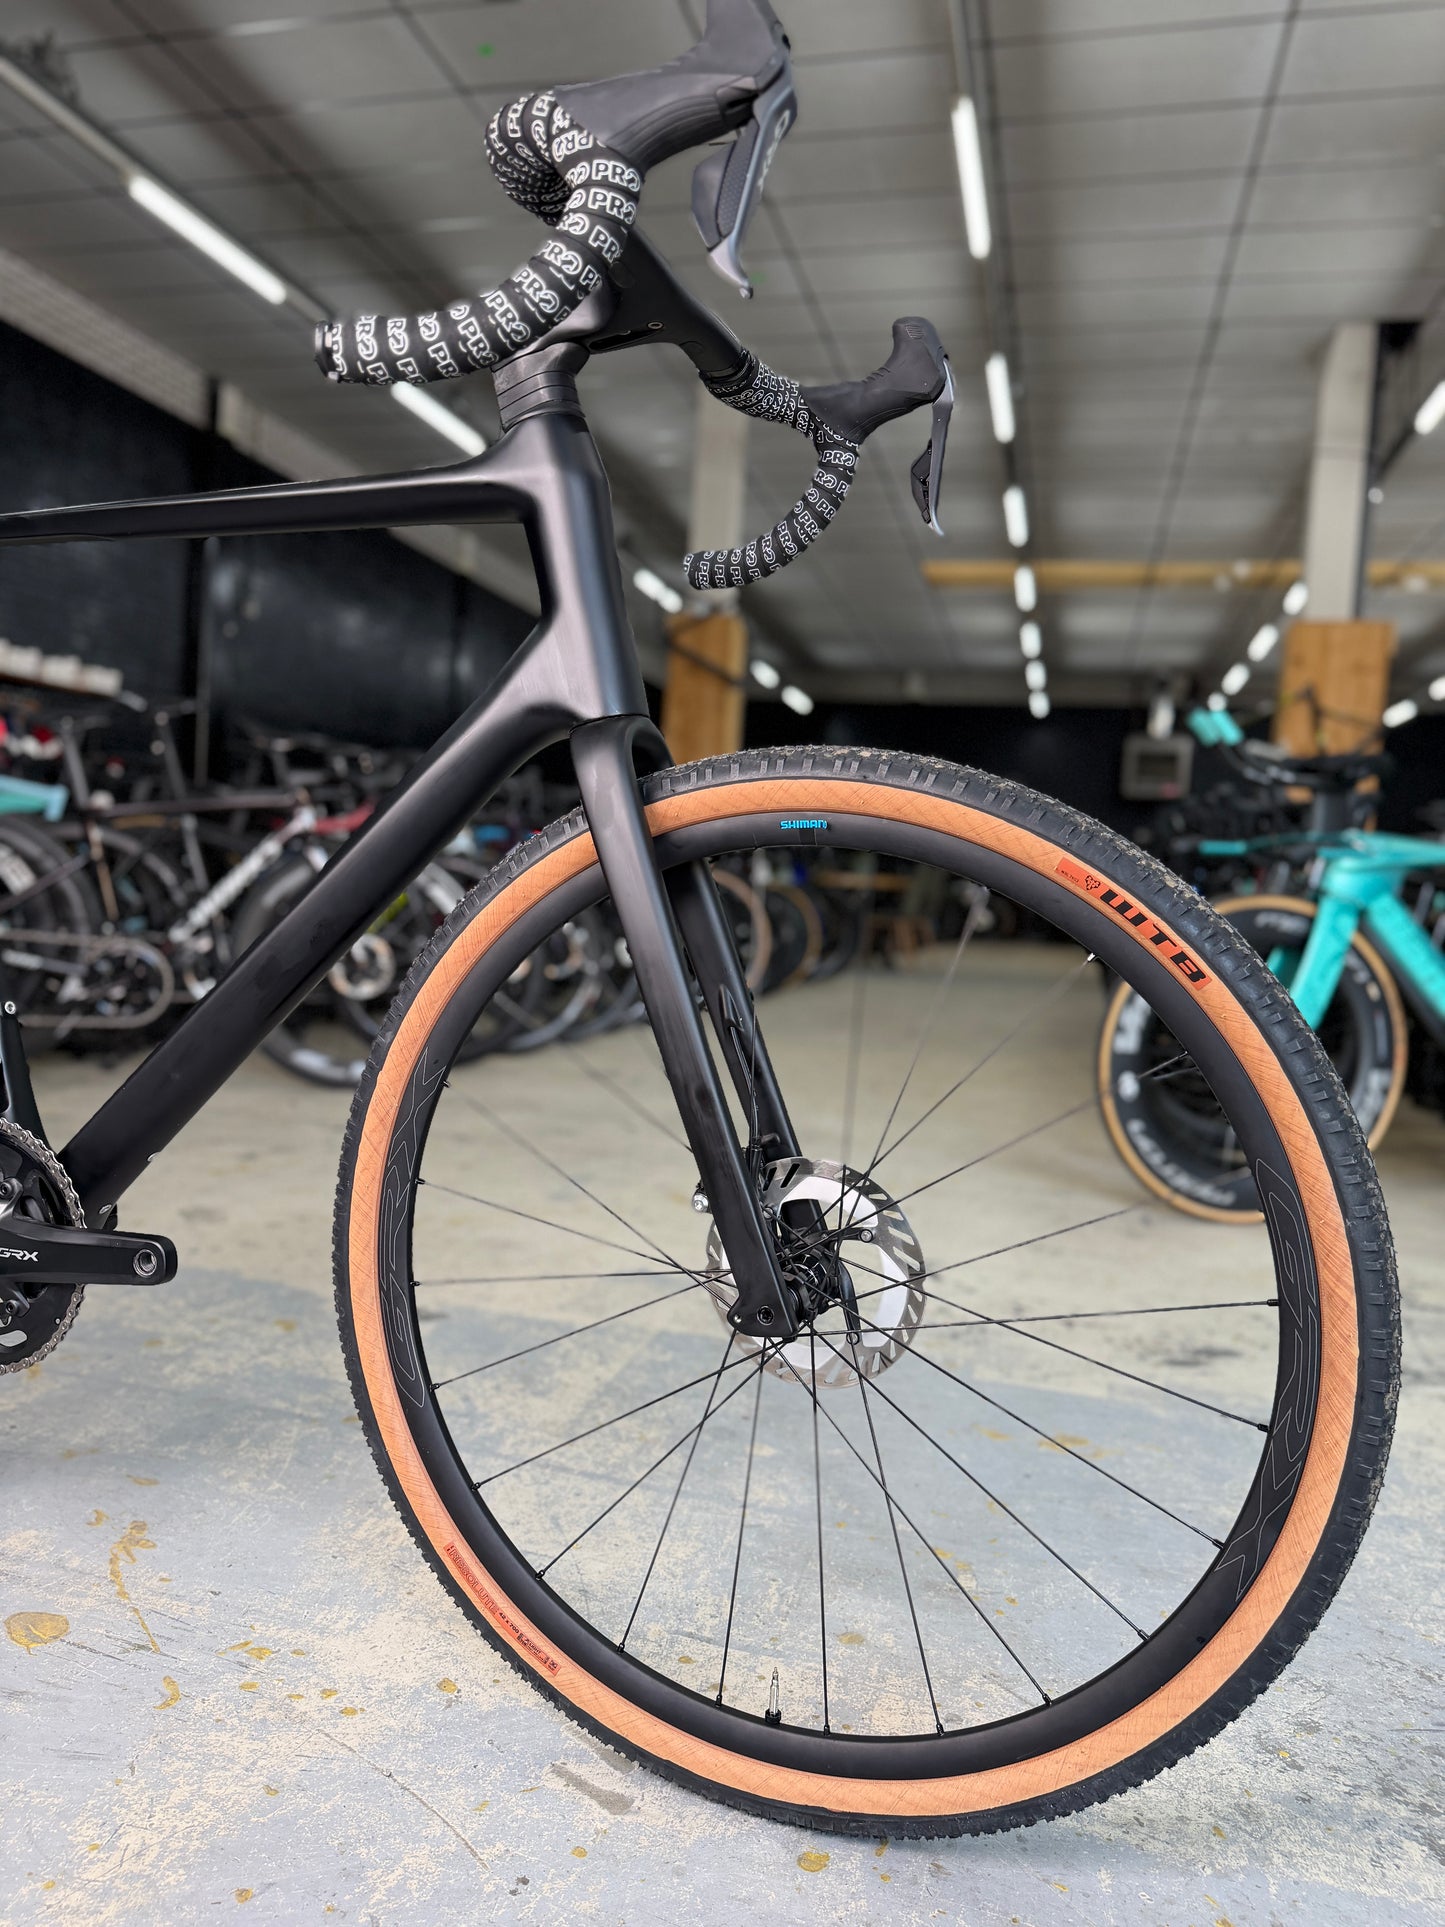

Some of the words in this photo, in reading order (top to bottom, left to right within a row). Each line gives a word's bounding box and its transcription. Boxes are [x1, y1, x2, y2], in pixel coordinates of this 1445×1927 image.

[591, 159, 640, 192] PRO
[588, 188, 637, 225] PRO
[588, 225, 624, 263] PR
[513, 267, 560, 313] PRO
[485, 290, 531, 343] PRO
[356, 315, 378, 361] RO
[387, 318, 409, 355] RO
[427, 341, 461, 377] PR
[822, 450, 855, 467] PRO
[815, 469, 837, 489] RO
[816, 499, 836, 520] PR
[746, 542, 758, 566] RO
[762, 533, 776, 563] RO
[777, 521, 798, 555] PRO
[715, 565, 726, 588] PR
[730, 566, 744, 586] PR
[0, 1248, 39, 1262] GRX
